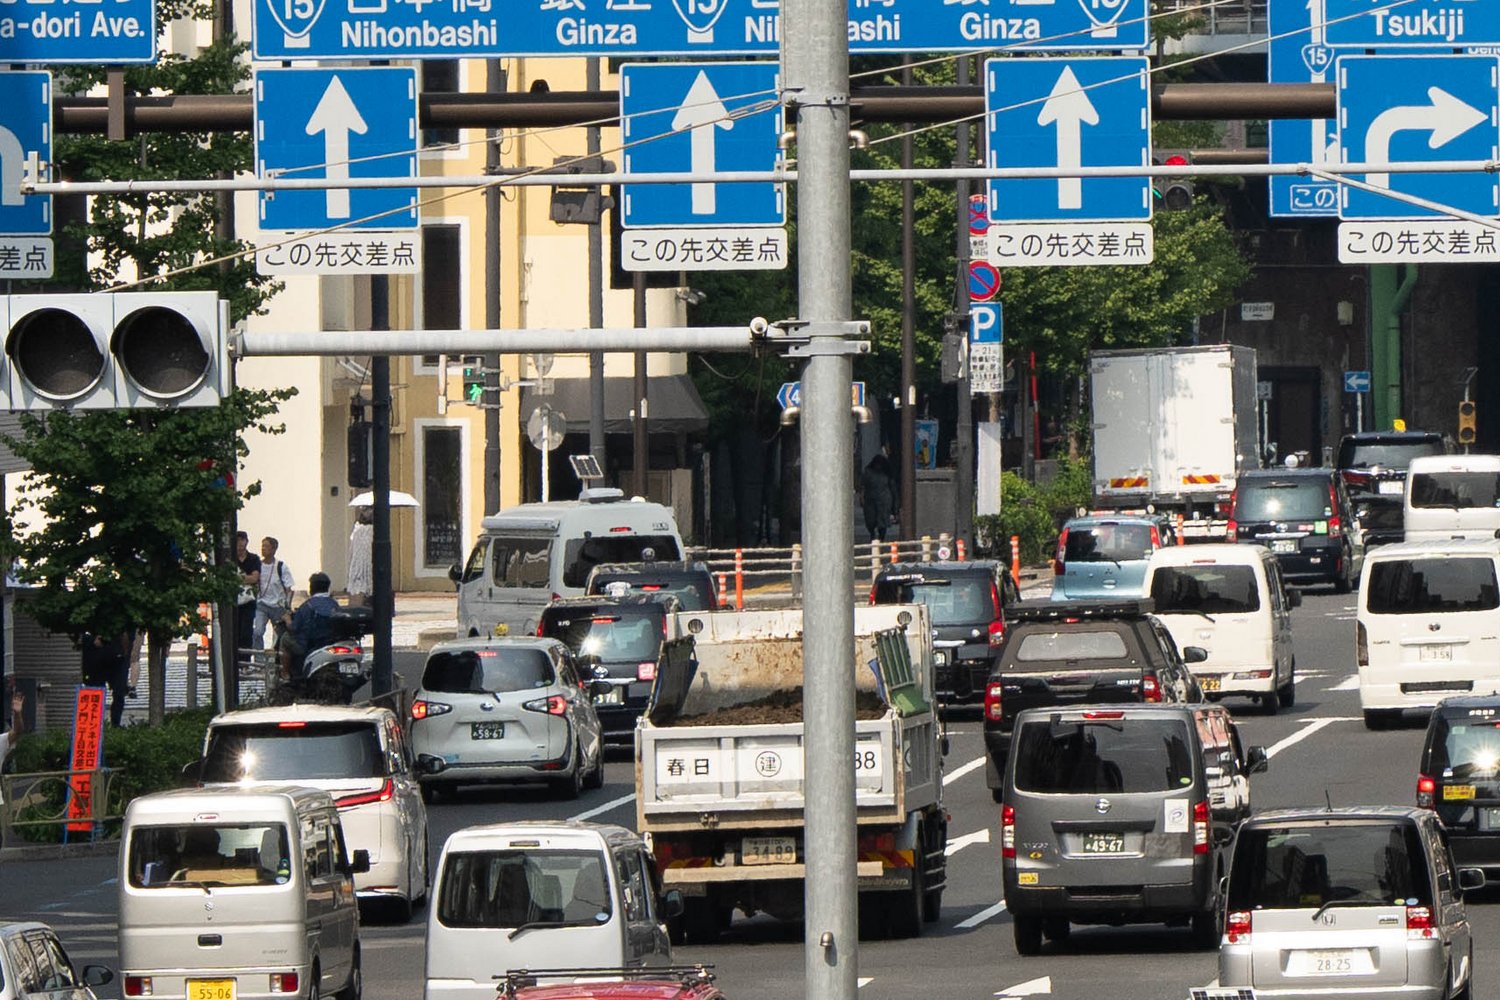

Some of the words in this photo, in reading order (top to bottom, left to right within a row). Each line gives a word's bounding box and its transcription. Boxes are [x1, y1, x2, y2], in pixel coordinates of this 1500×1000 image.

[90, 12, 145, 38] Ave.
[341, 19, 497, 48] Nihonbashi
[555, 17, 638, 46] Ginza
[959, 12, 1041, 40] Ginza
[1371, 8, 1464, 41] Tsukiji
[1308, 48, 1328, 65] 15
[1293, 188, 1338, 208] この
[264, 241, 415, 268] この先交差点
[630, 237, 781, 263] この先交差点
[996, 232, 1147, 258] この先交差点
[1347, 230, 1498, 255] この先交差点
[971, 306, 996, 340] P
[667, 758, 710, 776] 春日
[1092, 840, 1123, 852] 49-67
[1317, 959, 1351, 971] 28-25
[199, 988, 232, 1000] 55-06
